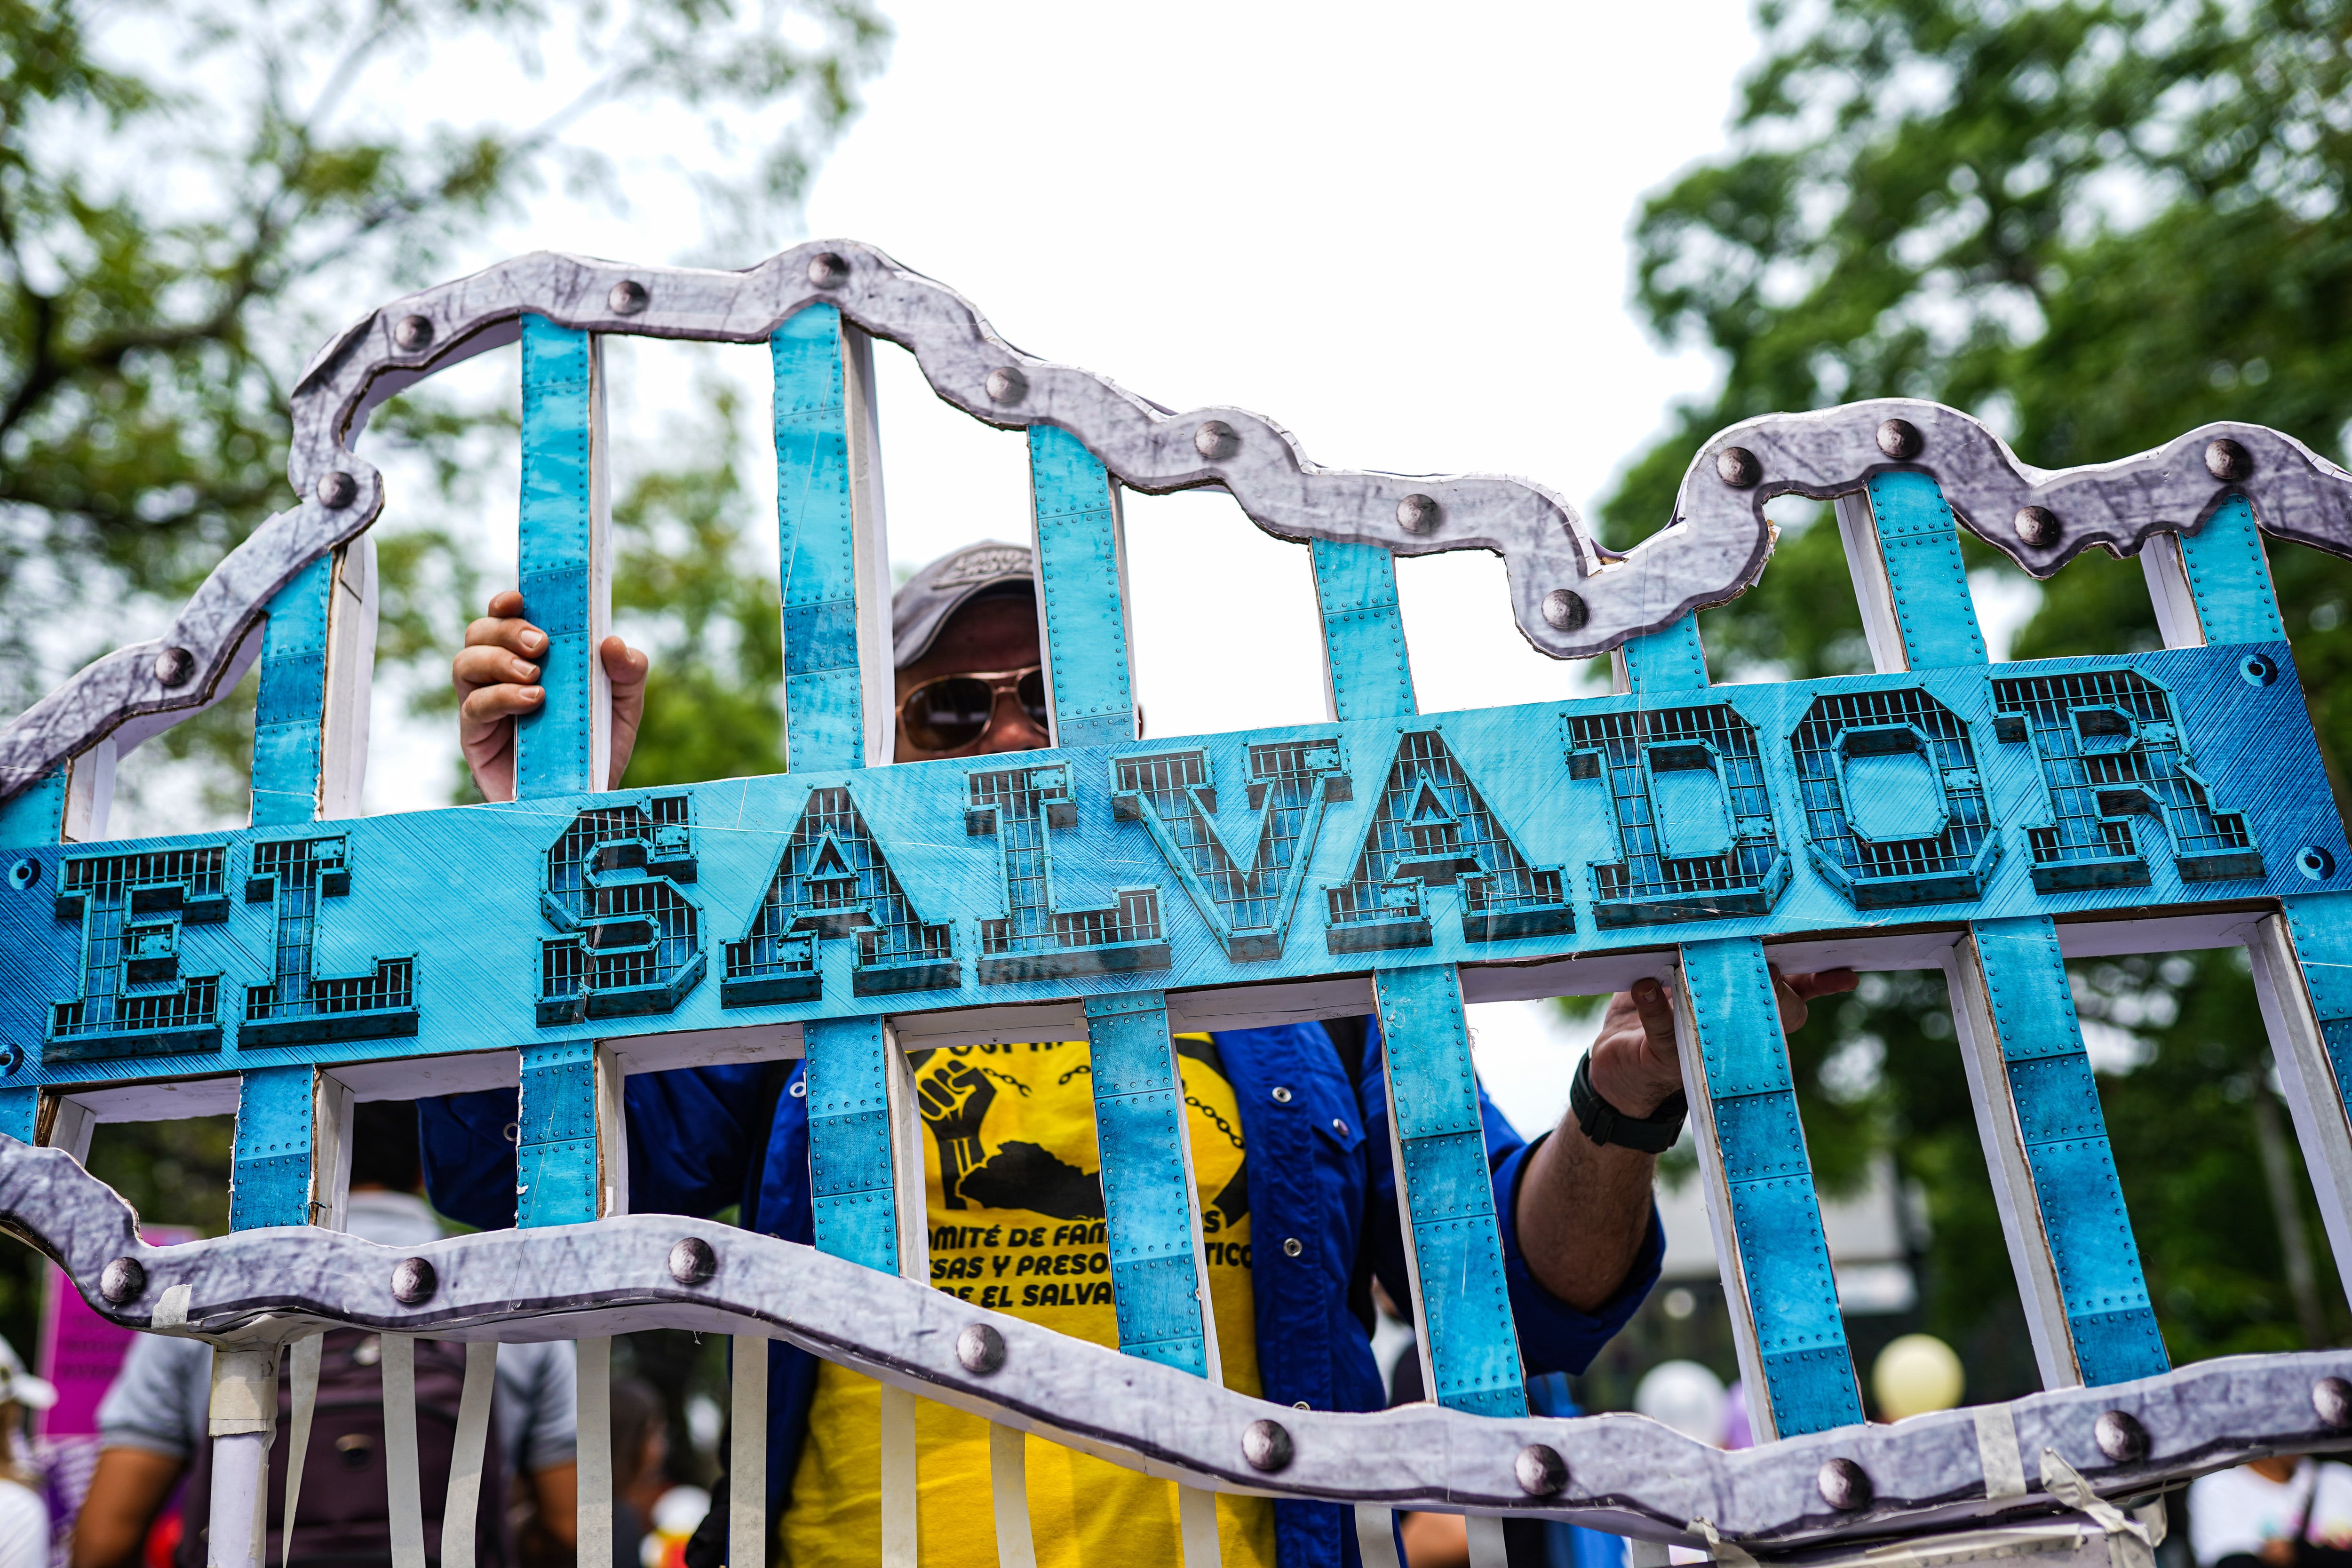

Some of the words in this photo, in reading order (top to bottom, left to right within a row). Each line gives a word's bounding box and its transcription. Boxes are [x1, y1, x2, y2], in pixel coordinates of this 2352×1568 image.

[964, 559, 1033, 575] ROVE
[42, 829, 421, 1066] EL
[535, 662, 2269, 1028] SALVADOR
[1008, 1226, 1047, 1247] DE
[930, 1256, 985, 1280] SAS
[993, 1255, 1012, 1277] Y
[980, 1285, 1014, 1308] EL
[1021, 1281, 1115, 1307] SALVA
